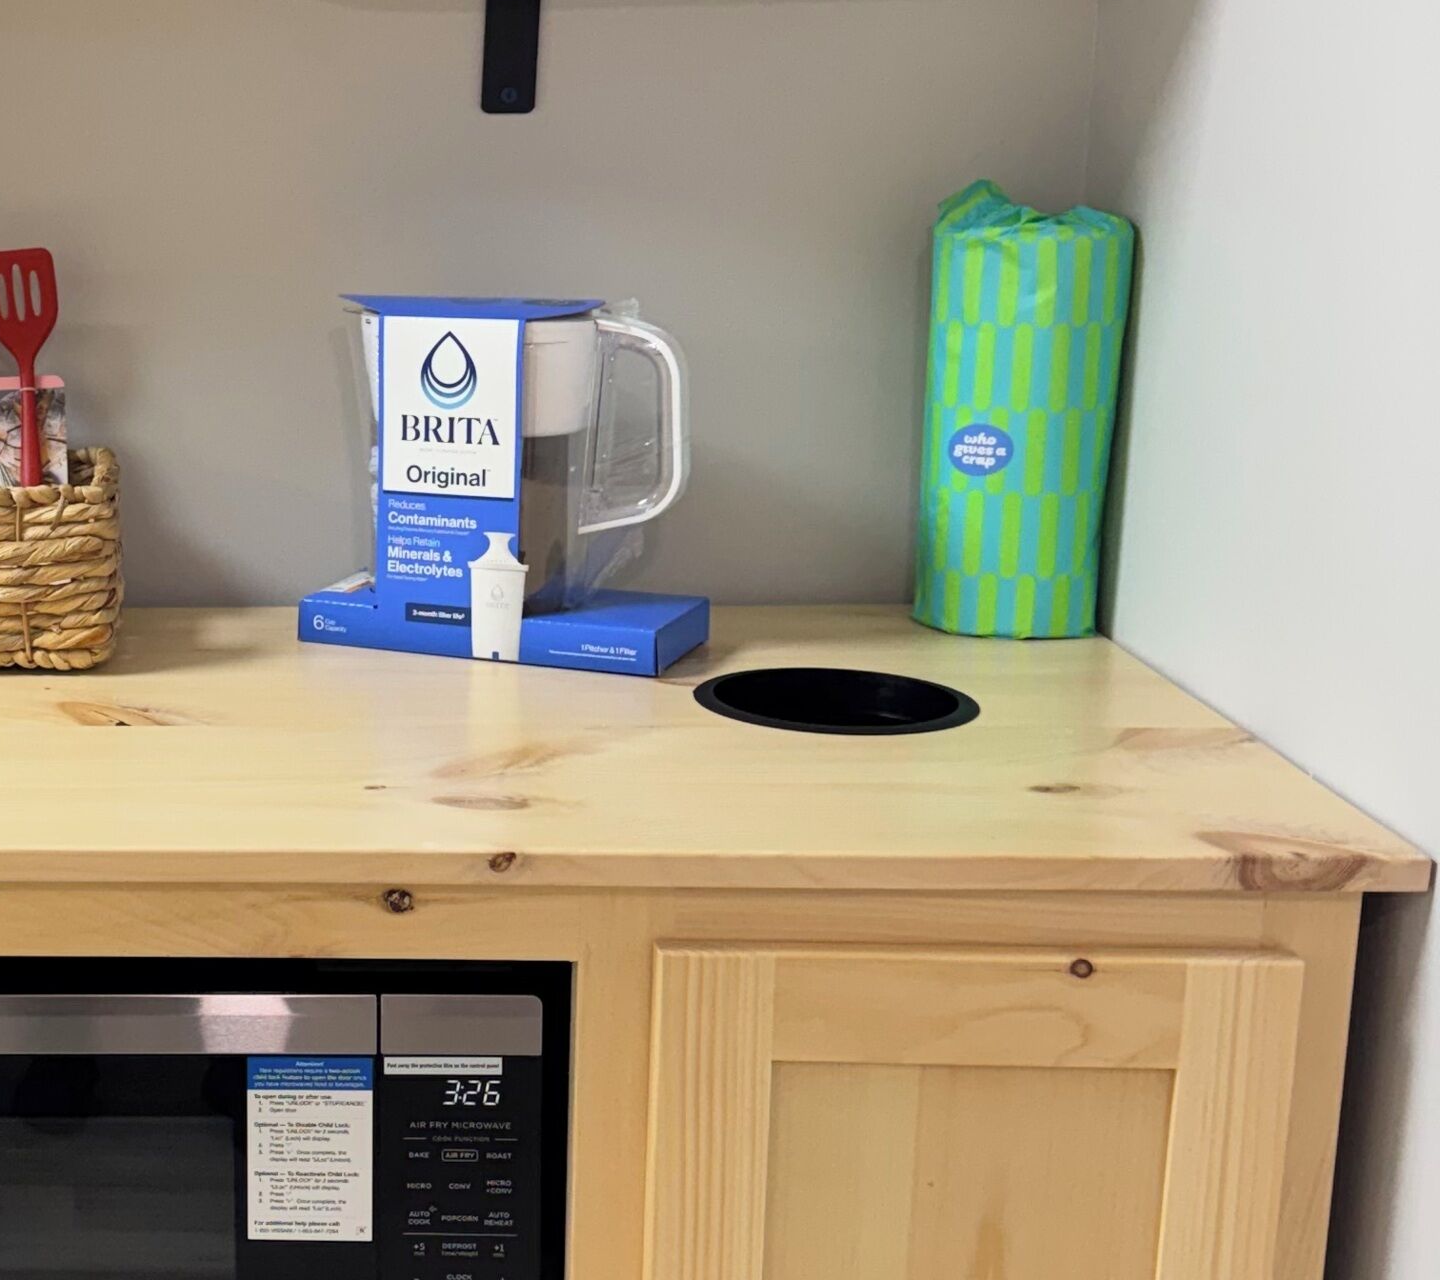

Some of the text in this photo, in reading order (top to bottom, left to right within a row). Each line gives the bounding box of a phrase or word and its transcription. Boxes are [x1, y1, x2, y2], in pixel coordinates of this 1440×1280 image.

[402, 415, 500, 445] BRITA
[964, 432, 996, 445] who
[953, 444, 1006, 457] gives a
[962, 455, 995, 469] crap
[407, 465, 486, 488] Original
[388, 499, 426, 511] Reduces
[388, 511, 477, 529] Contaminants
[388, 535, 440, 547] Helps Retain
[388, 546, 452, 562] Minerals &
[388, 560, 463, 578] Electrolytes
[313, 615, 324, 630] 6
[325, 624, 346, 633] Capacity
[443, 1080, 501, 1106] 3:26
